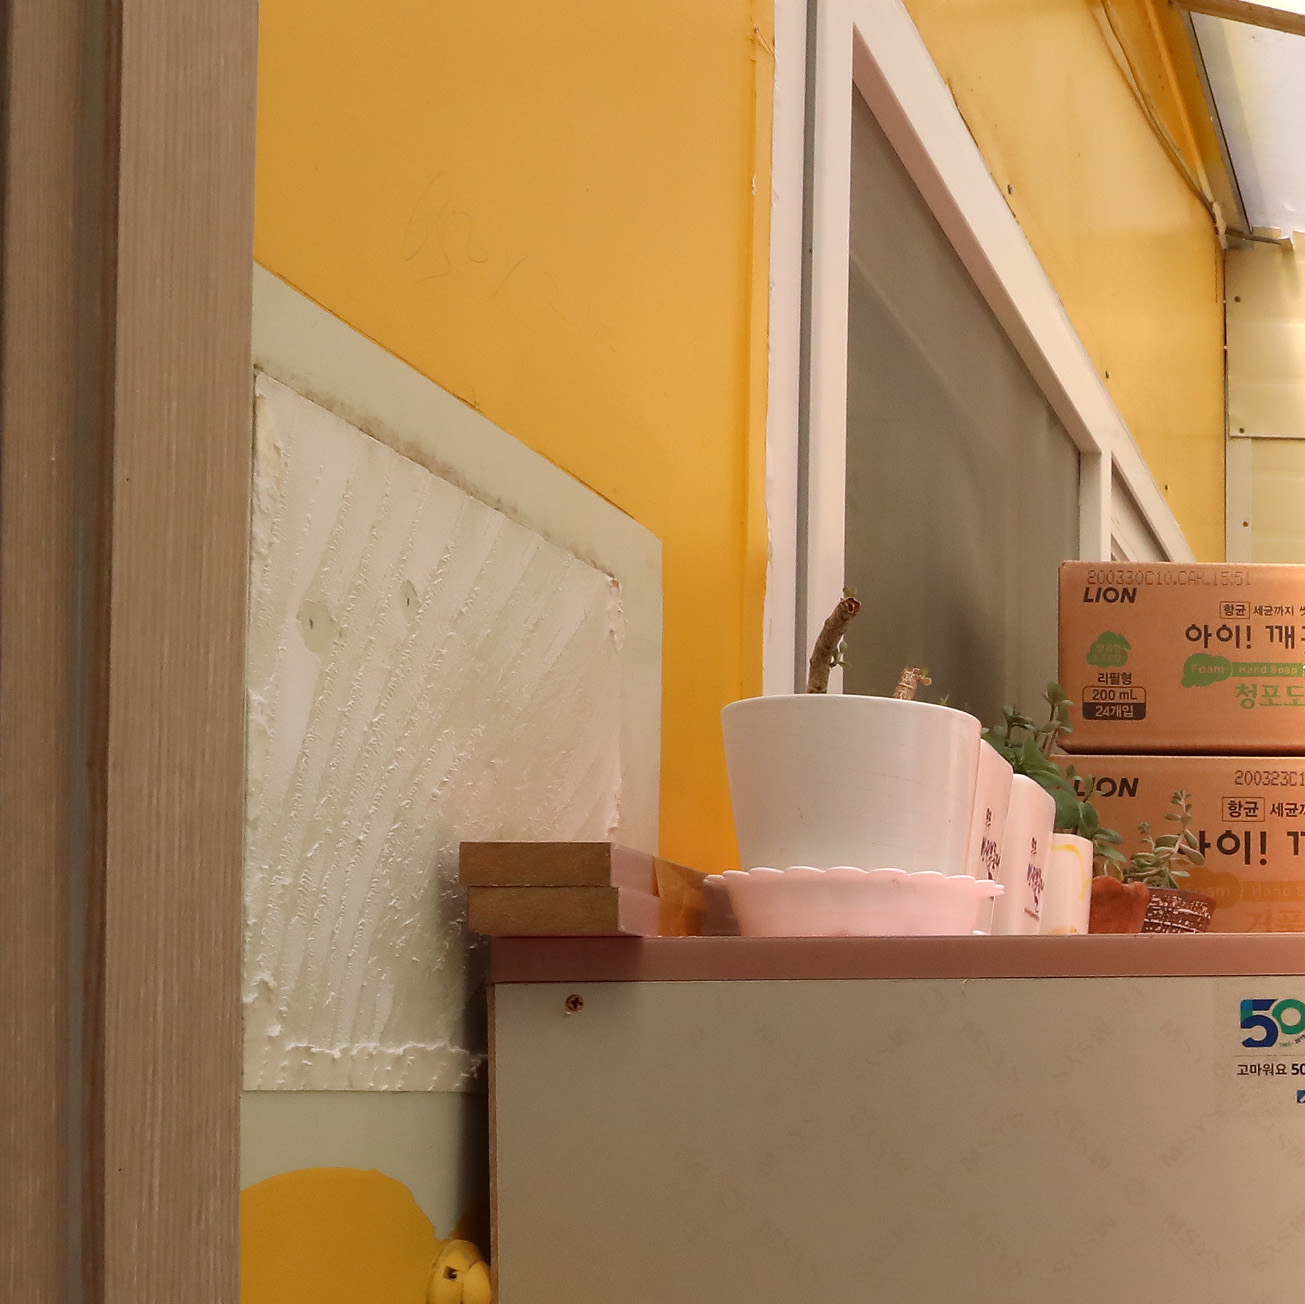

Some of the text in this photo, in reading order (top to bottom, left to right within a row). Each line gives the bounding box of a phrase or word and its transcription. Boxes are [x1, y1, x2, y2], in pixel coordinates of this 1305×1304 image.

[1083, 587, 1138, 603] LION
[1223, 604, 1247, 617] 항균
[1253, 605, 1295, 617] 세균까지
[1184, 623, 1253, 650] 아이!
[1190, 664, 1298, 675] Foam Hand Soap
[1097, 672, 1132, 685] 리필형
[1092, 689, 1138, 701] 200 mL
[1095, 704, 1134, 718] 24개입
[1227, 800, 1260, 818] 항균
[1251, 884, 1293, 897] Hand
[1236, 1063, 1288, 1076] 고마워요
